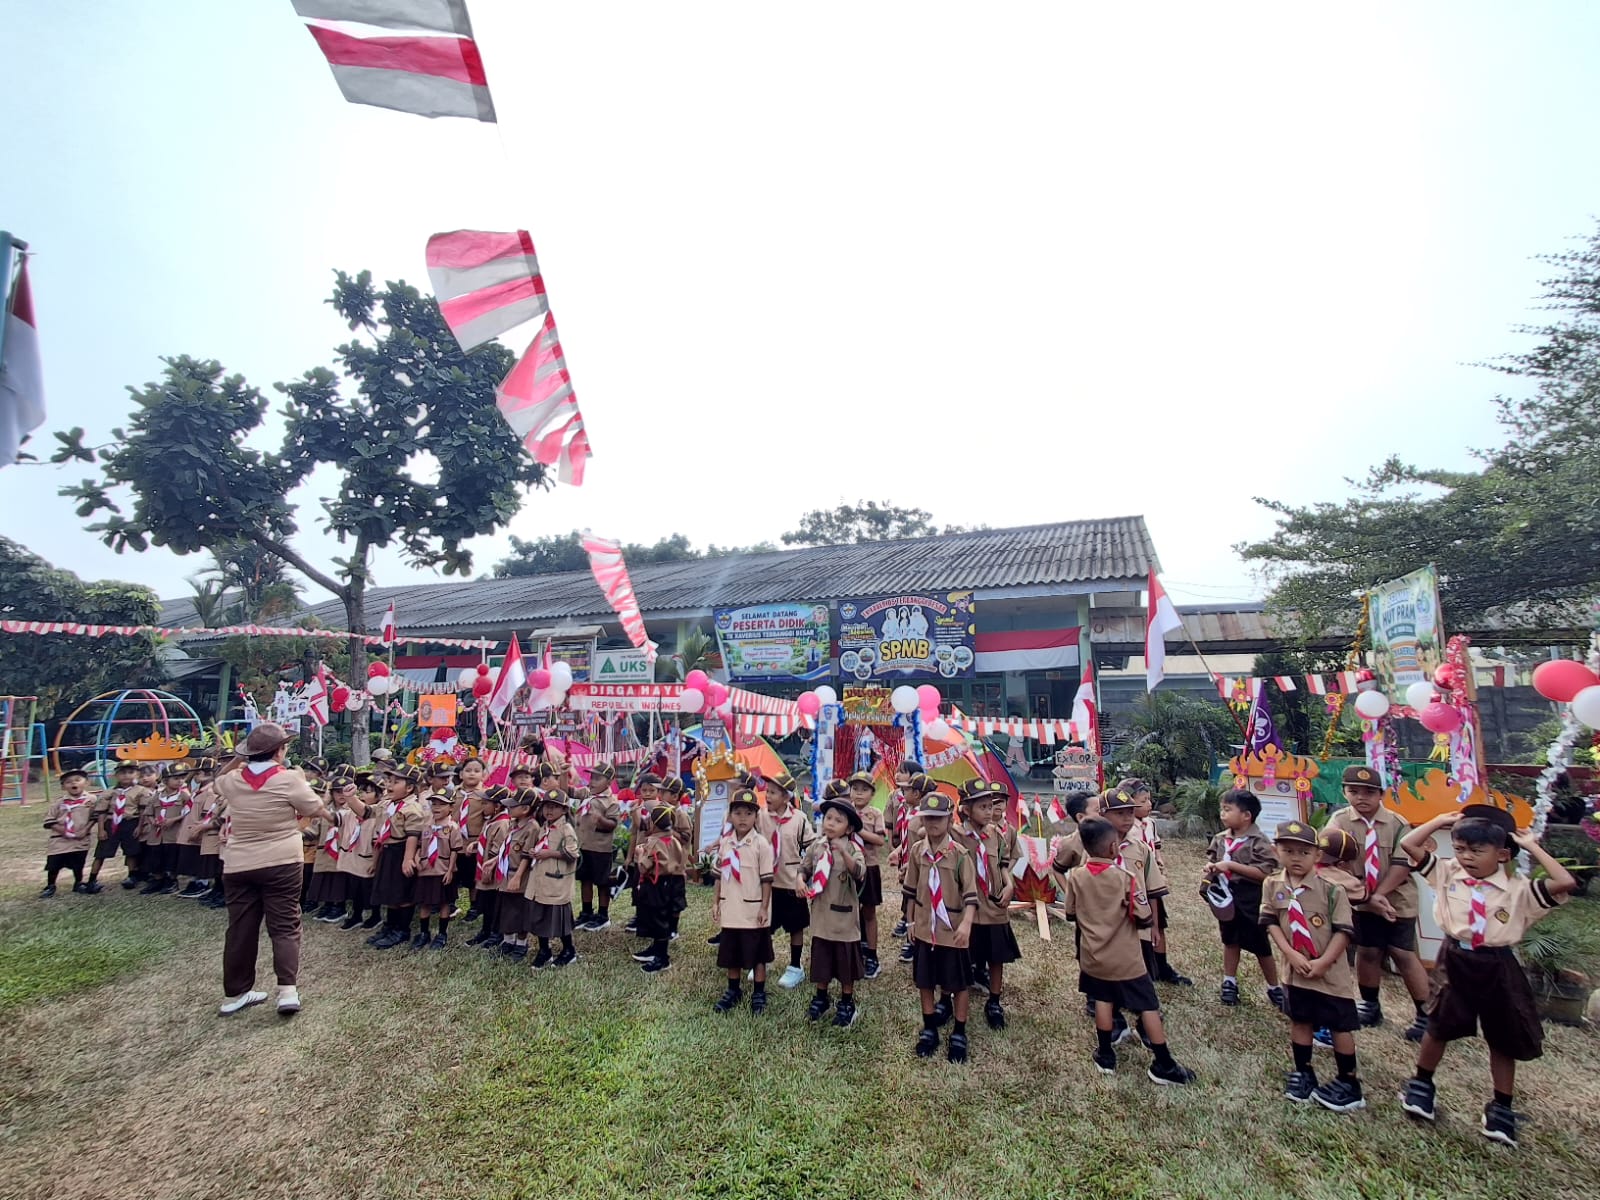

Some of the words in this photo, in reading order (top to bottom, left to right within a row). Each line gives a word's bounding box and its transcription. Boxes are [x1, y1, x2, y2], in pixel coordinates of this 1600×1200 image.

[741, 612, 770, 620] SELAMAT
[1383, 608, 1395, 625] HUT
[1396, 604, 1416, 620] PRAM
[733, 620, 776, 631] PESERTA
[778, 619, 805, 629] DIDIK
[880, 638, 930, 662] SPMB
[620, 660, 647, 672] UKS
[590, 685, 634, 695] DIRGA
[641, 685, 683, 695] HAYU
[591, 701, 634, 709] REPUBLIK
[642, 702, 681, 710] INDONES
[1056, 753, 1096, 763] EXPLORE
